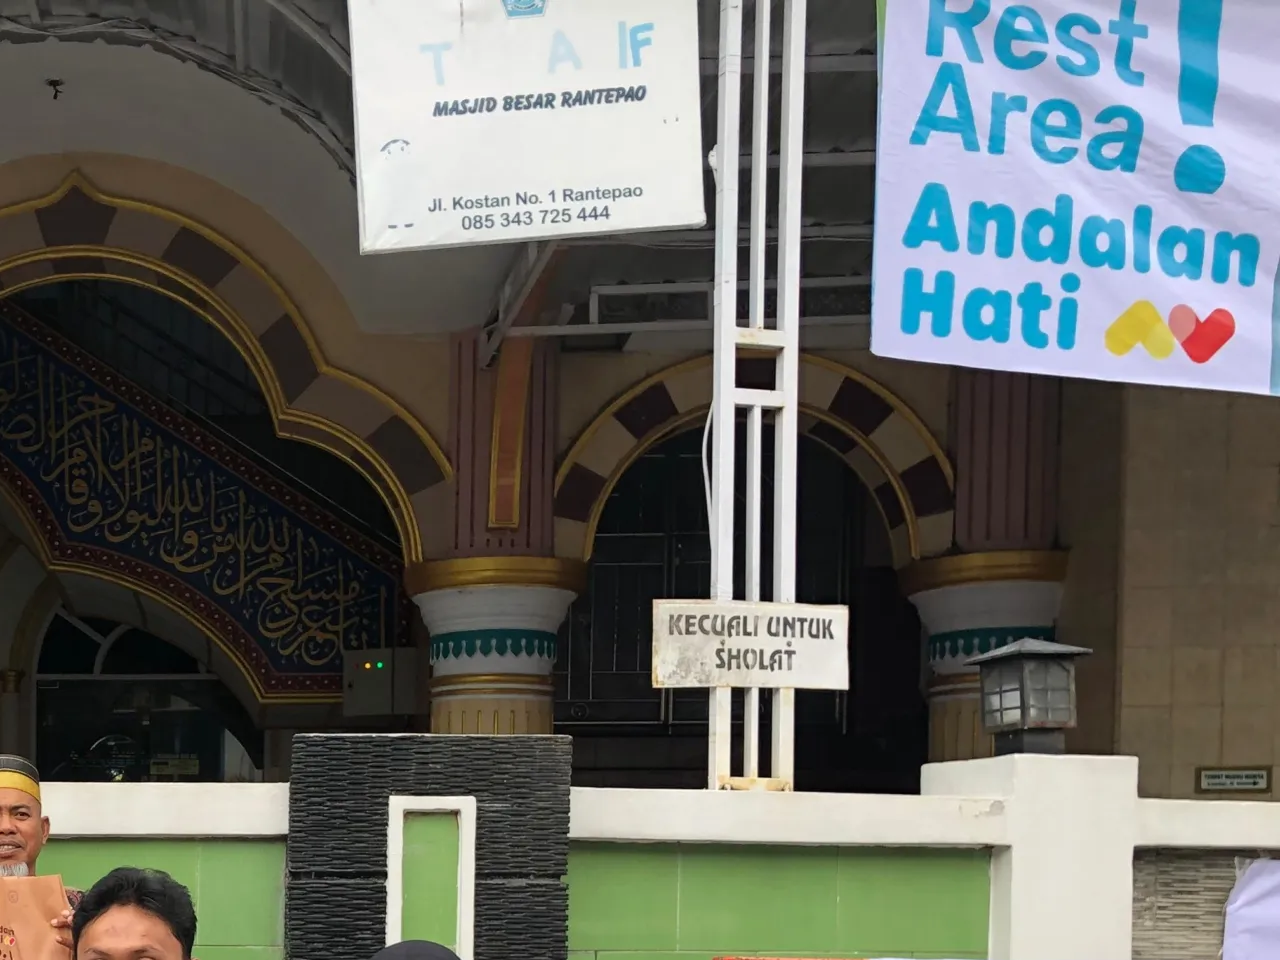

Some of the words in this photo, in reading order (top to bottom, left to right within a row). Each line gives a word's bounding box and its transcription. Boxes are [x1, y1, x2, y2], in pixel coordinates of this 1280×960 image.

[926, 0, 1149, 86] Rest
[433, 97, 497, 117] MASJID
[503, 93, 555, 112] BESAR
[561, 85, 646, 108] RANTEPAO
[909, 61, 1144, 173] Area
[428, 197, 447, 213] Jl.
[452, 192, 510, 211] Kostan
[516, 191, 543, 207] No.
[548, 190, 557, 204] 1
[563, 184, 643, 204] Rantepao
[462, 213, 494, 230] 085
[500, 210, 533, 228] 343
[539, 207, 572, 225] 725
[576, 205, 610, 222] 444
[902, 182, 1260, 287] Andalan
[900, 267, 1081, 350] Hati
[669, 614, 759, 637] KECUALI
[767, 616, 834, 640] UNTUK
[715, 648, 796, 671] SHOLAT
